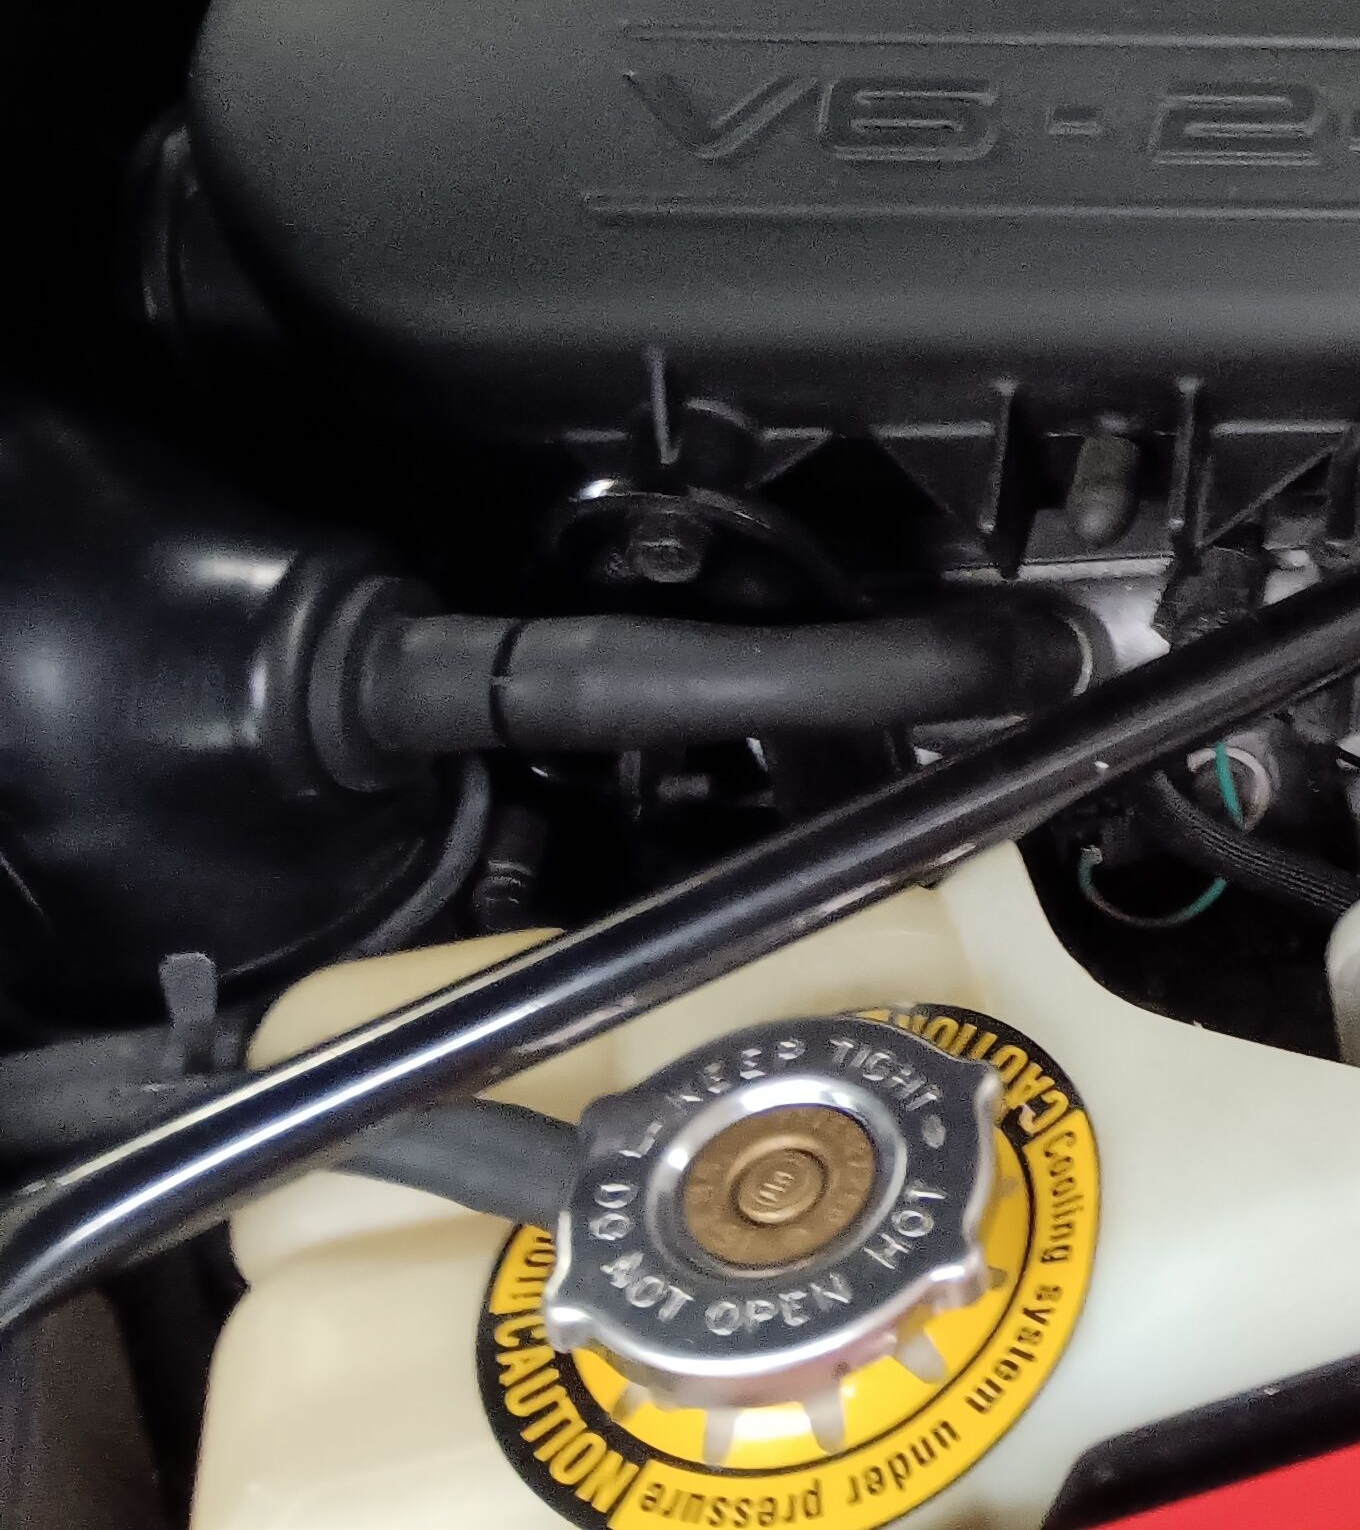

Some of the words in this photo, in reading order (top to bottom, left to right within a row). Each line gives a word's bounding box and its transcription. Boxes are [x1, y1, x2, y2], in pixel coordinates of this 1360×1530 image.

[622, 68, 1000, 165] V6
[829, 1035, 944, 1113] TIGHT
[1043, 1130, 1084, 1265] Cooling
[601, 1249, 695, 1322] NOT
[703, 1271, 852, 1337] OPEN
[862, 1179, 948, 1270] HOT
[964, 1284, 1063, 1415] system
[493, 1310, 640, 1515] CAUTION
[846, 1419, 961, 1507] under
[639, 1476, 823, 1529] pressure
